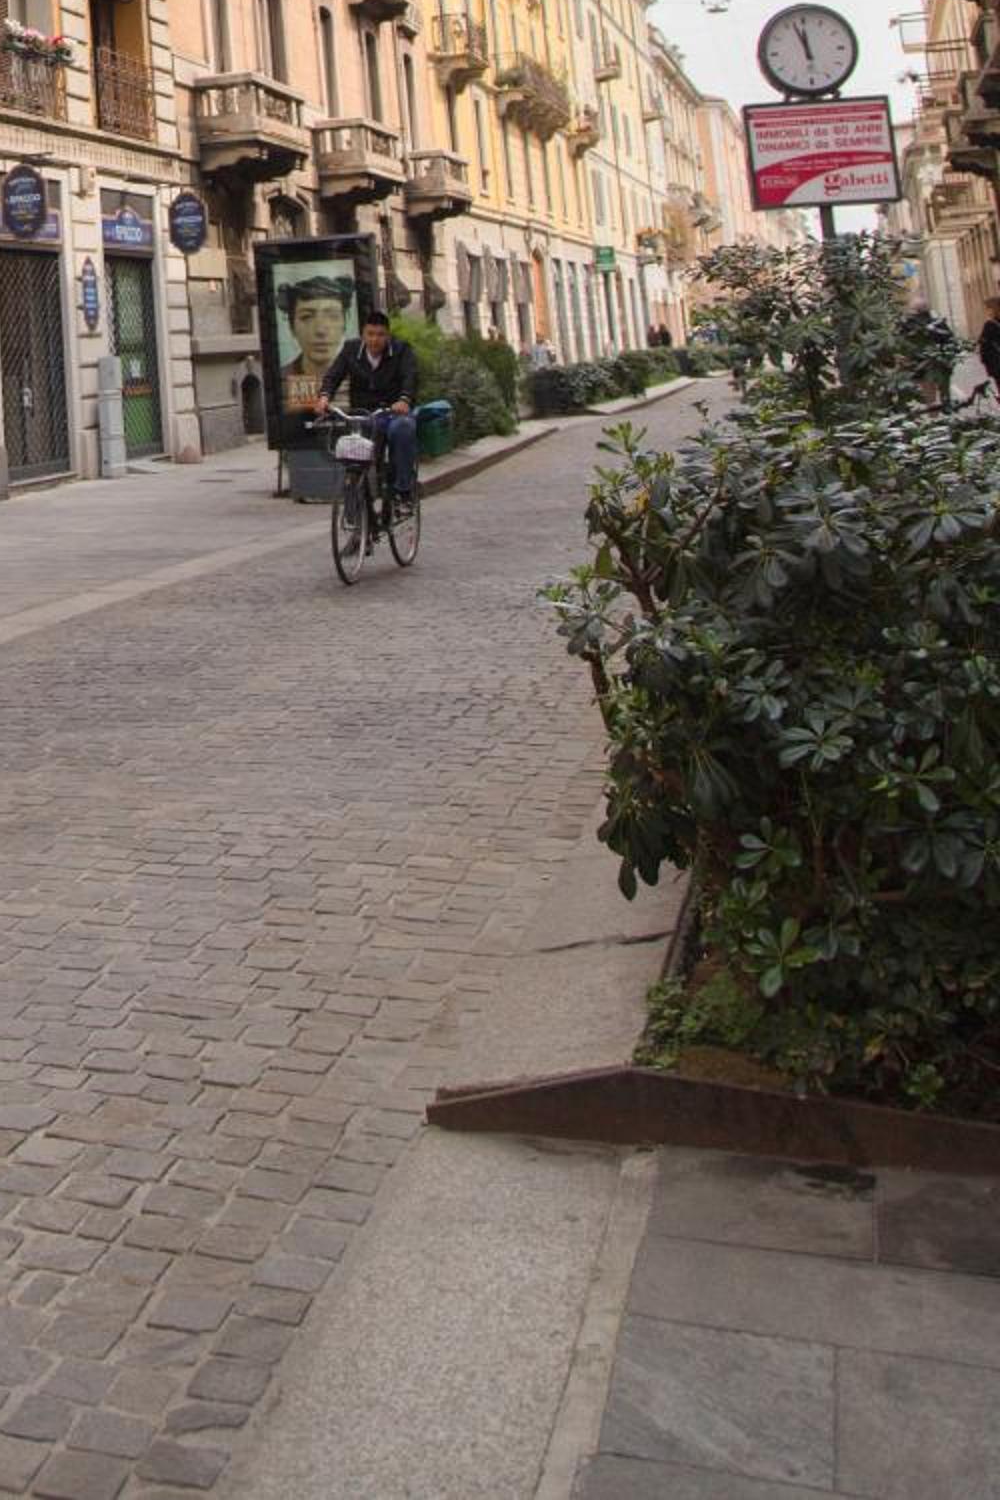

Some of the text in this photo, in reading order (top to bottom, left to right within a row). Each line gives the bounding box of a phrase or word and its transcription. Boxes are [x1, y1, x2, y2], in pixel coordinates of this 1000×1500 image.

[755, 128, 809, 140] IMMOBILI
[854, 123, 883, 134] ANNI
[757, 141, 810, 152] DINAMICI
[834, 136, 883, 148] SEMPRE
[824, 173, 889, 197] gabetti
